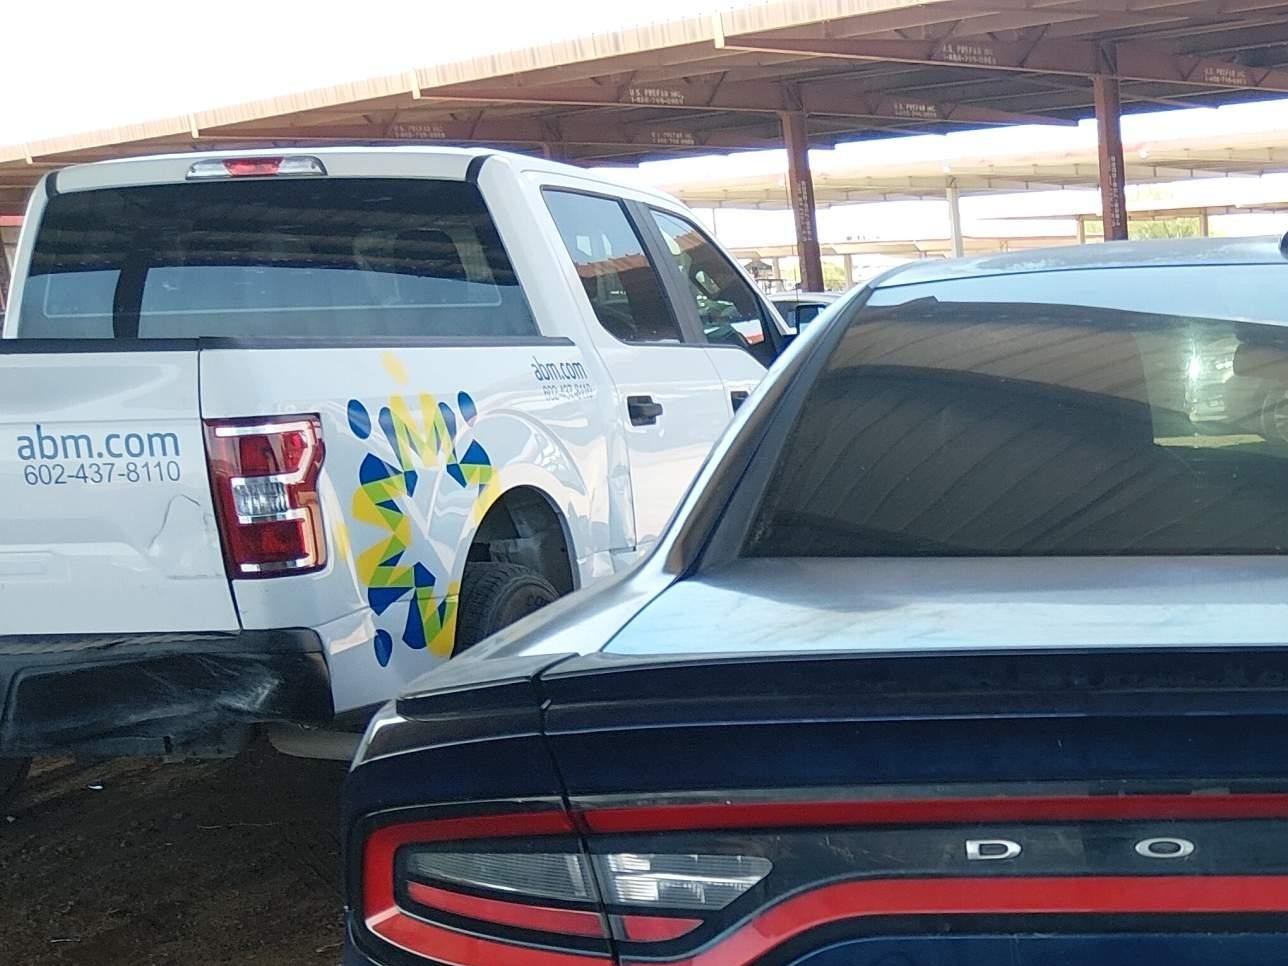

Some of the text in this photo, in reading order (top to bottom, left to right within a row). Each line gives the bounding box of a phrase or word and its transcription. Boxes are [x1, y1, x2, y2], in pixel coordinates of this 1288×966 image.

[531, 355, 588, 381] abm.com
[17, 423, 180, 461] abm.com
[24, 460, 181, 485] 602-437-8110
